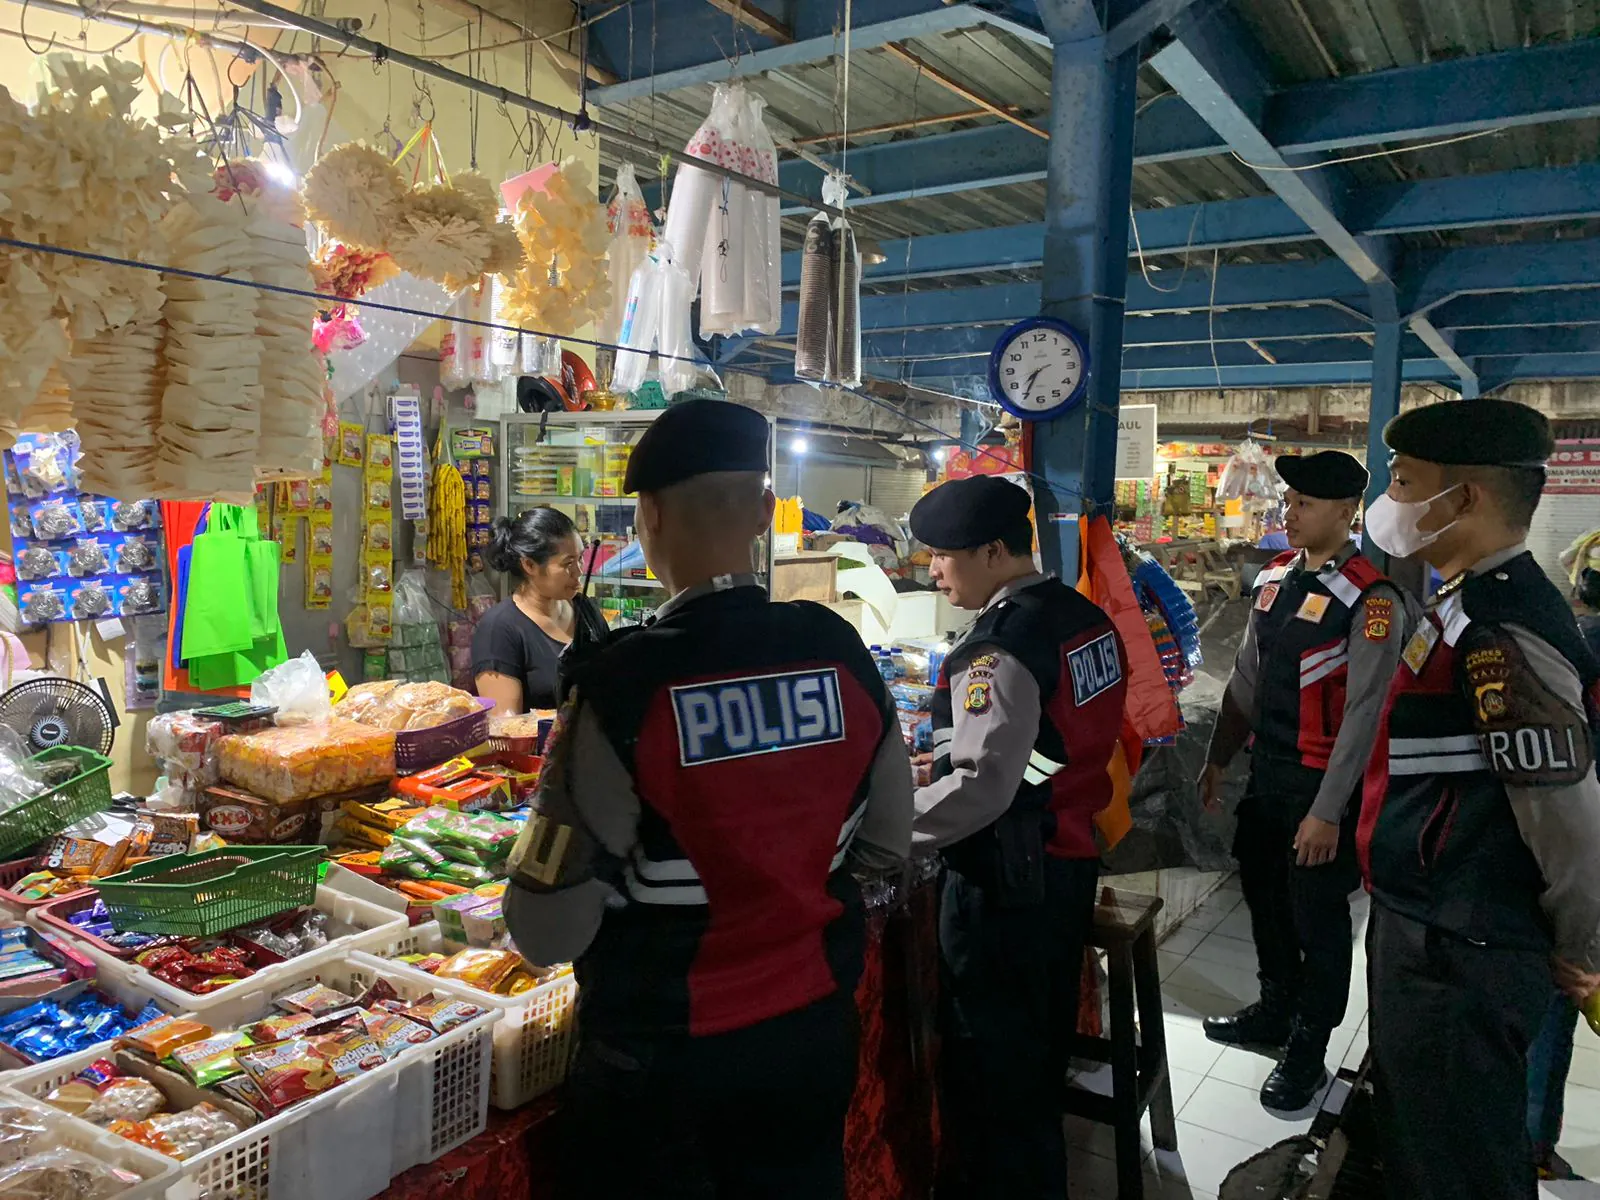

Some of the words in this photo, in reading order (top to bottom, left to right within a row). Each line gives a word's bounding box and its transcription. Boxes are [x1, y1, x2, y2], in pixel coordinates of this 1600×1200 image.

[1033, 333, 1047, 342] 12
[1021, 341, 1029, 349] 11
[1061, 348, 1071, 356] 2
[1010, 353, 1022, 362] 10
[1066, 361, 1076, 370] 3
[1005, 367, 1015, 375] 9
[1061, 377, 1071, 385] 4
[1010, 382, 1019, 390] 8
[1022, 392, 1030, 400] 7
[1051, 389, 1061, 398] 5
[1036, 395, 1046, 404] 6
[1071, 636, 1121, 700] POLISI
[680, 676, 840, 757] POLISI
